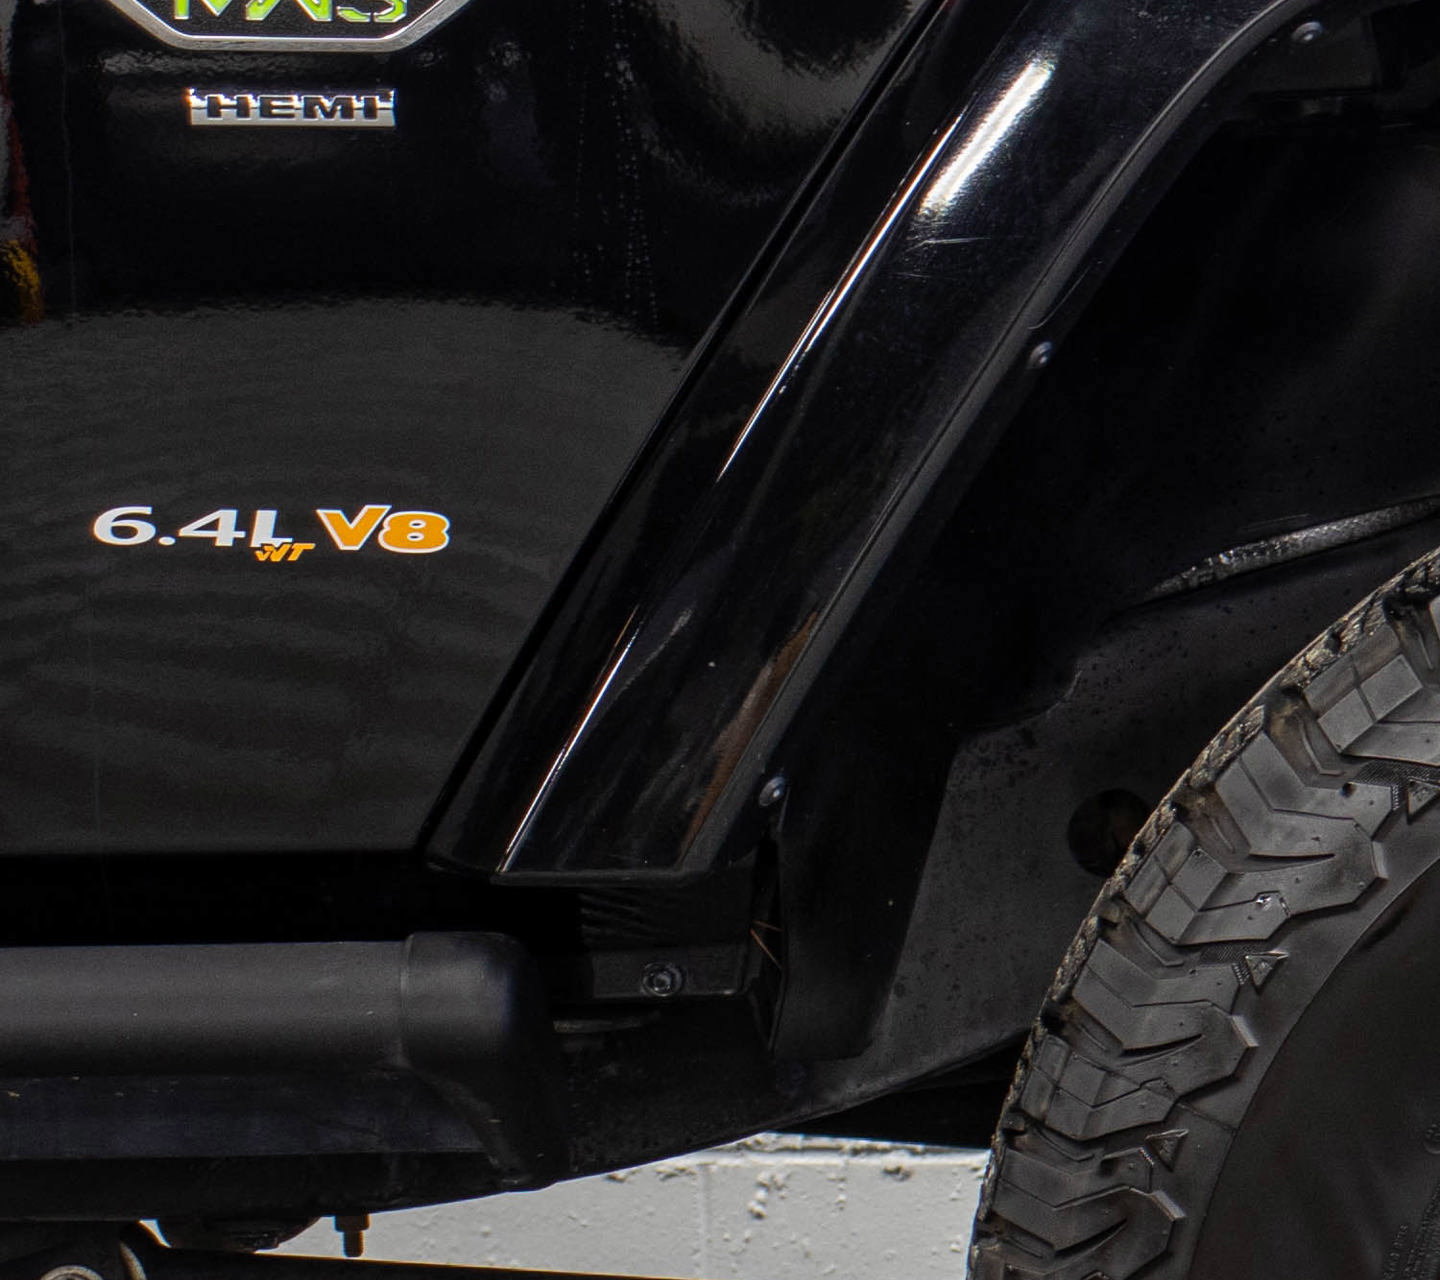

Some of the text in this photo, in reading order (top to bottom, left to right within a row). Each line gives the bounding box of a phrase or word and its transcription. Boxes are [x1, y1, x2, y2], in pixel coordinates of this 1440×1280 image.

[205, 93, 380, 121] HEMI
[93, 504, 450, 554] 6.4L V8
